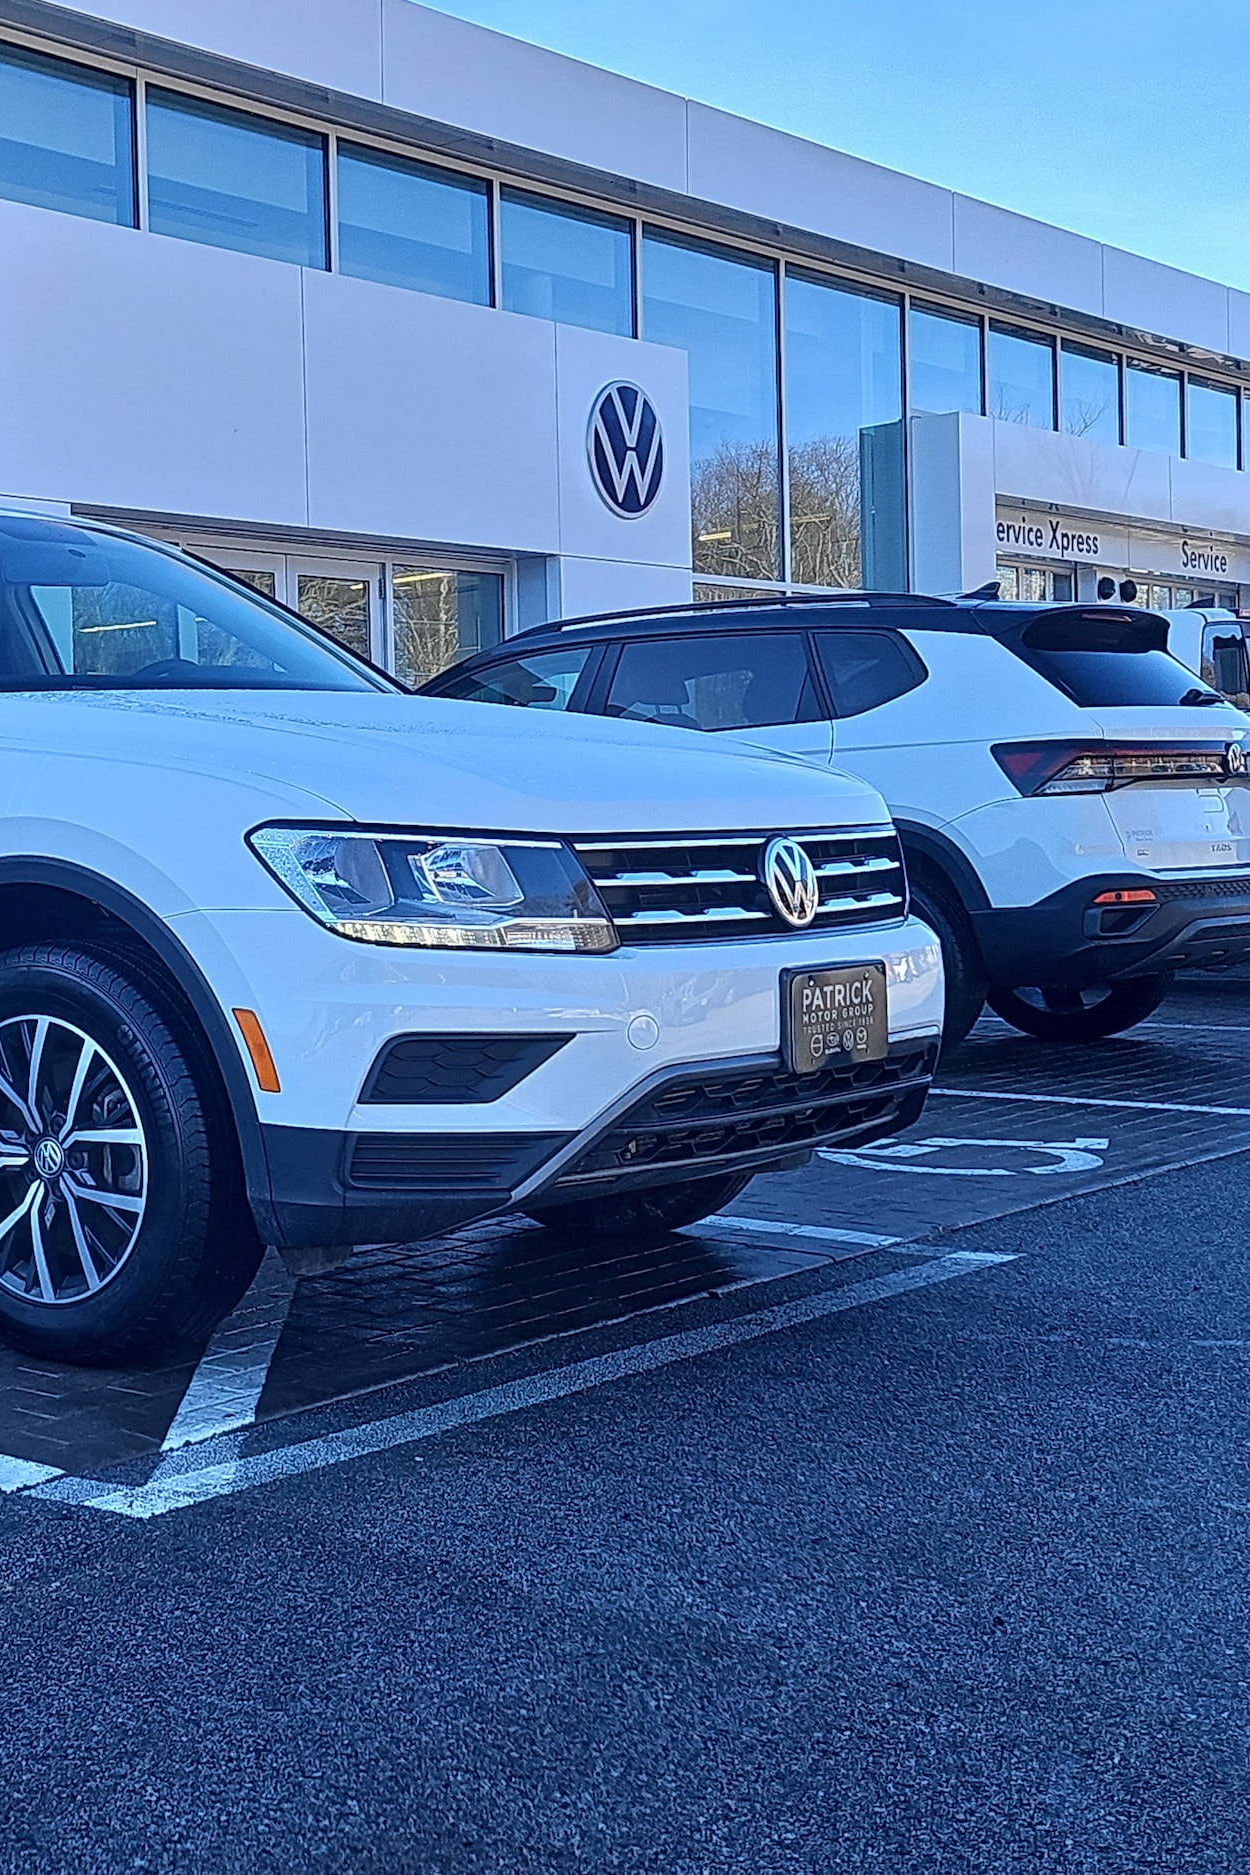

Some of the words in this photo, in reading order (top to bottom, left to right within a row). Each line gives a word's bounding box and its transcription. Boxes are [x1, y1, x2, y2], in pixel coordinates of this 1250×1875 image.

[996, 516, 1043, 547] ervice
[1048, 519, 1099, 558] Xpress
[1181, 540, 1228, 573] Service
[802, 980, 873, 1012] PATRICK
[802, 1009, 838, 1025] MOTOR
[842, 1003, 874, 1018] GROUP
